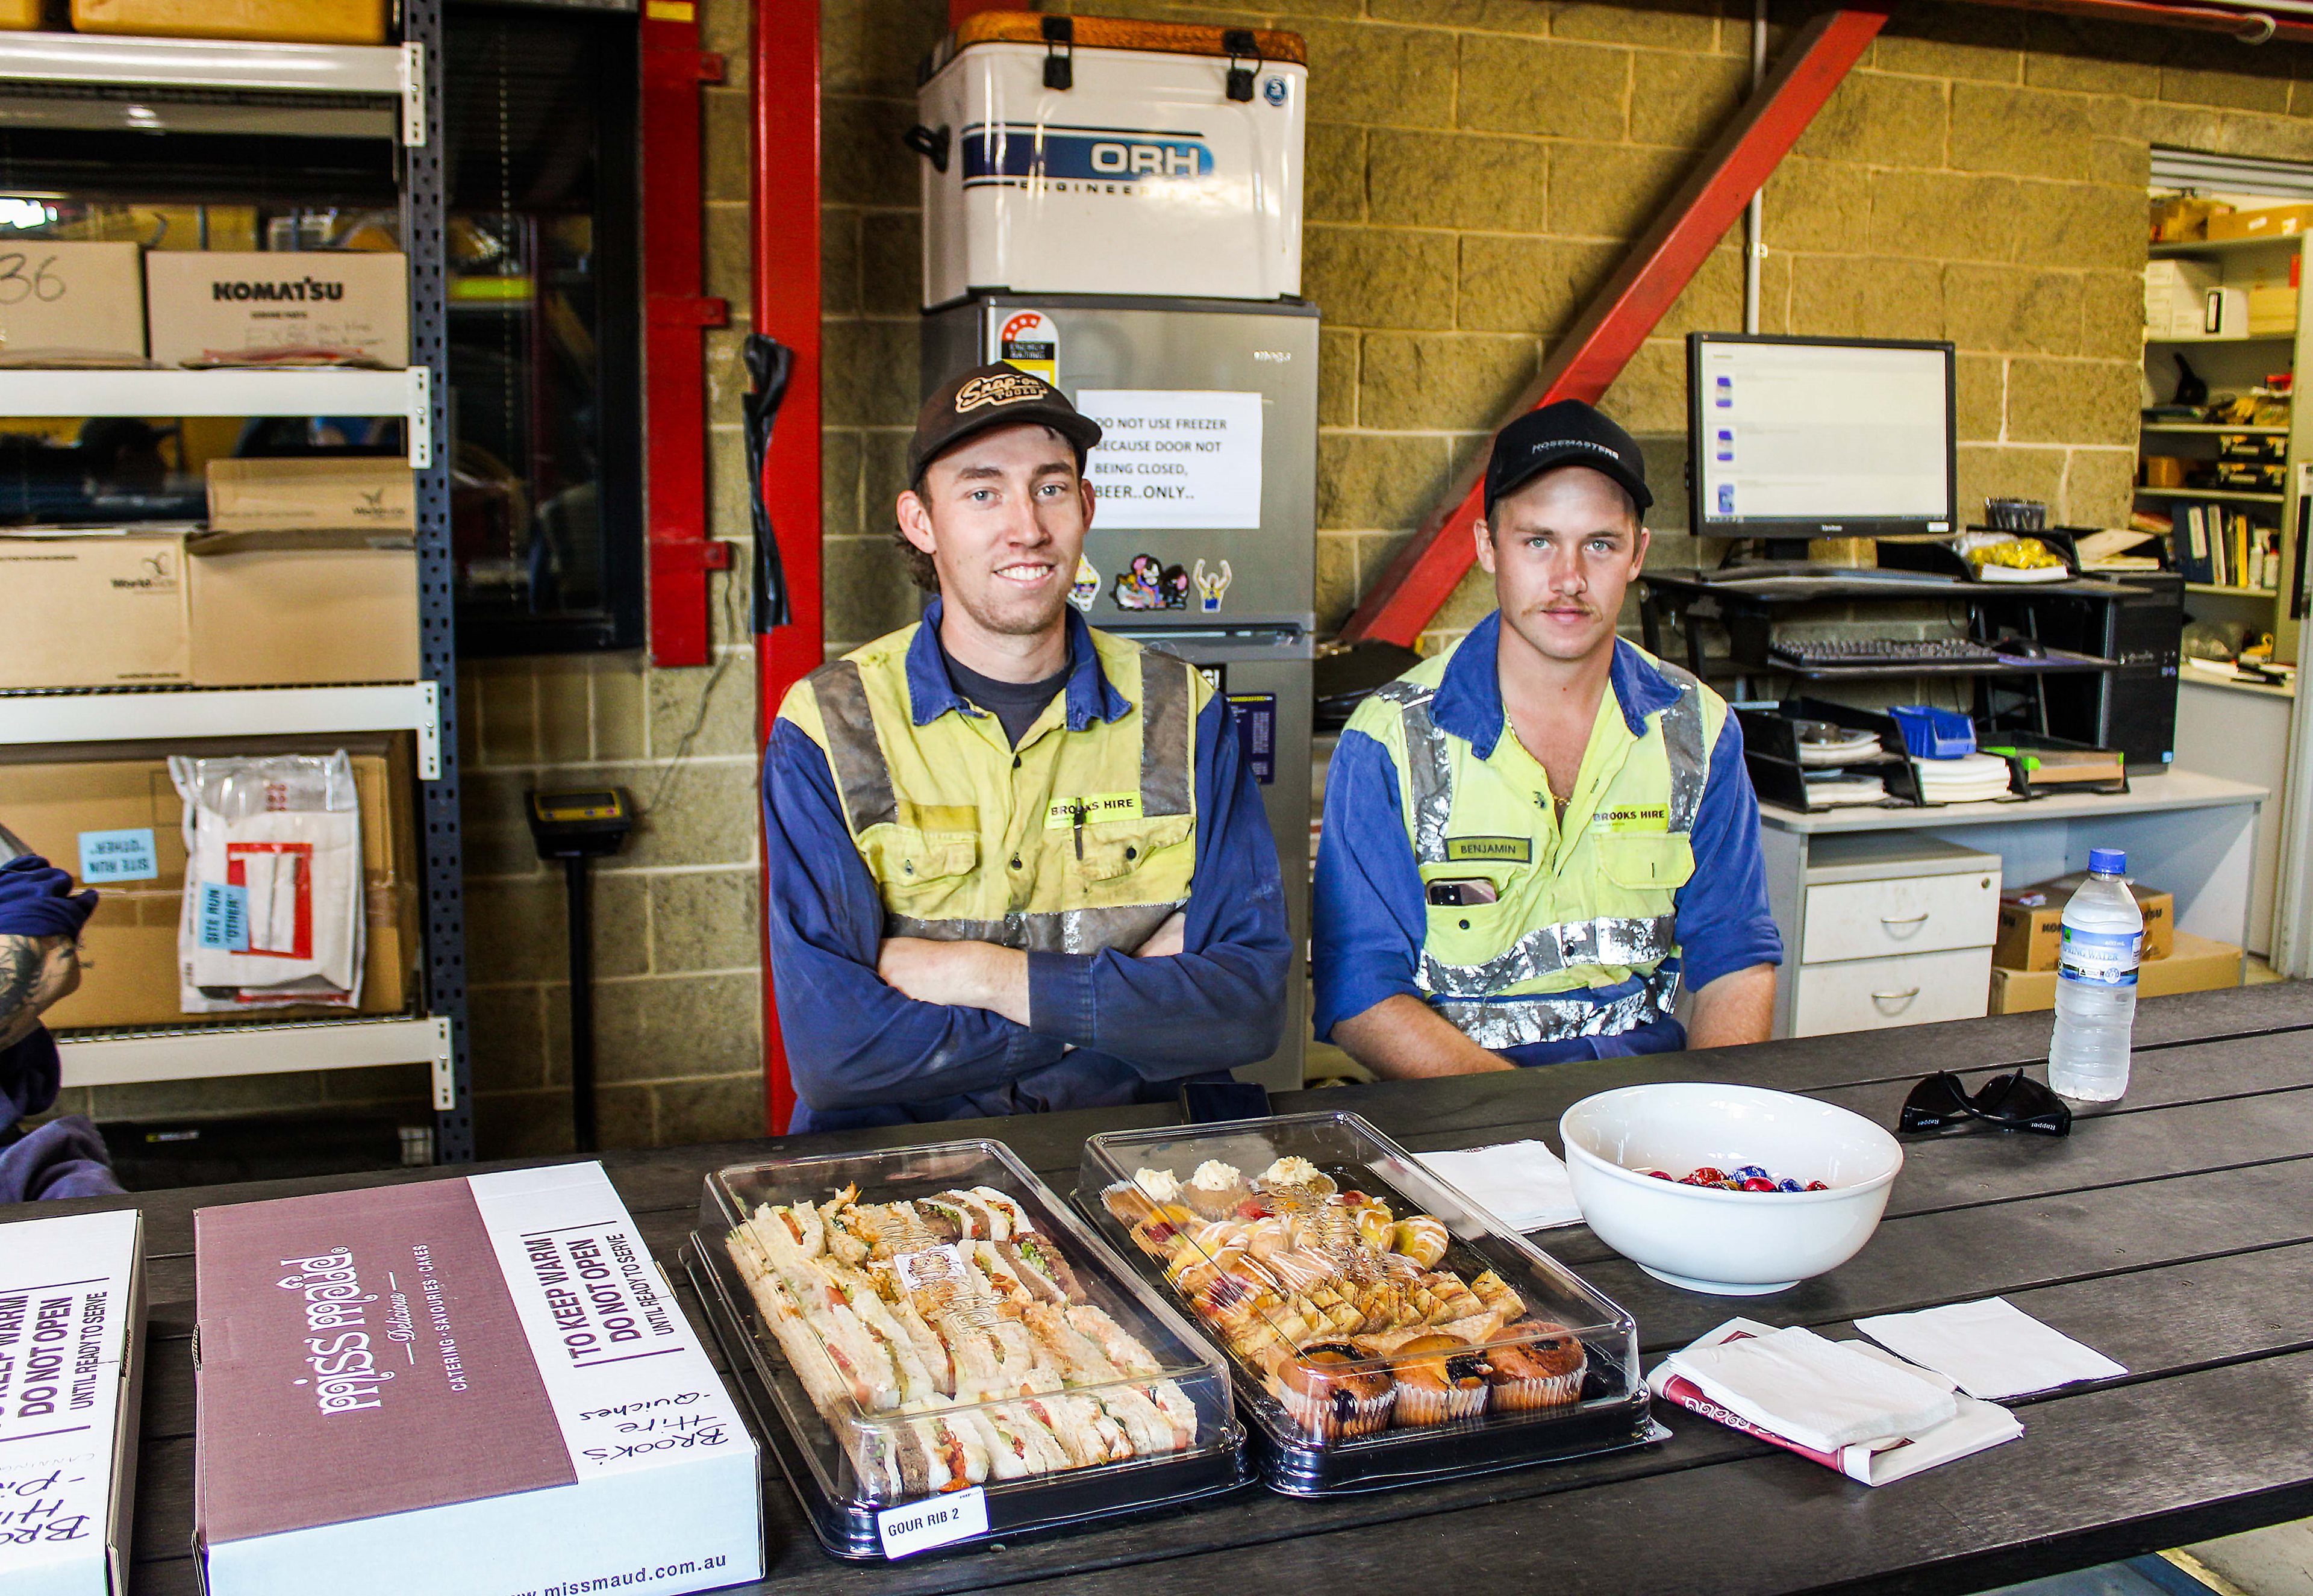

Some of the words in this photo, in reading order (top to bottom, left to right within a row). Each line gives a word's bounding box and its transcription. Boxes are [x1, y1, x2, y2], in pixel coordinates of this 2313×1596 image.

[1091, 142, 1199, 175] ORH
[213, 276, 343, 301] KOMATSU
[1094, 417, 1113, 429] DO
[1117, 417, 1144, 429] NOT
[1149, 417, 1171, 429] USE
[1176, 418, 1227, 429] FREEZER
[1094, 440, 1152, 452] BECAUSE
[1155, 441, 1191, 452] DOOR
[1196, 441, 1222, 452] NOT
[1094, 463, 1133, 474] BEING
[1137, 463, 1188, 476] CLOSED,
[1050, 802, 1099, 815] BROKS
[1104, 799, 1134, 809] HIRE
[1593, 811, 1637, 821] BROOKS
[1640, 809, 1665, 819] HIRE
[1461, 844, 1516, 854] BENJAMIN
[413, 1244, 434, 1273] CAKES
[523, 1238, 569, 1286] WARM
[566, 1238, 610, 1279] OPEN
[605, 1233, 636, 1264] SERVE
[620, 1264, 643, 1278] TO
[82, 1291, 108, 1324] SERVE
[422, 1278, 451, 1332] SAVOURIES
[585, 1283, 628, 1315] NOT
[626, 1279, 660, 1308] READY
[33, 1297, 73, 1342] OPEN
[385, 1291, 416, 1342] Delicious
[544, 1288, 590, 1331] KEEP
[644, 1306, 675, 1336] UNTIL
[80, 1325, 104, 1341] TO
[602, 1317, 642, 1342] DO
[74, 1341, 101, 1374] READY
[563, 1333, 601, 1359] TO
[23, 1347, 64, 1383] NOT
[439, 1338, 467, 1392] CATERING
[17, 1386, 58, 1418] DO
[69, 1374, 97, 1411] UNTIL
[888, 1517, 923, 1536] GOUR
[928, 1512, 948, 1526] RIB
[952, 1507, 960, 1520] 2
